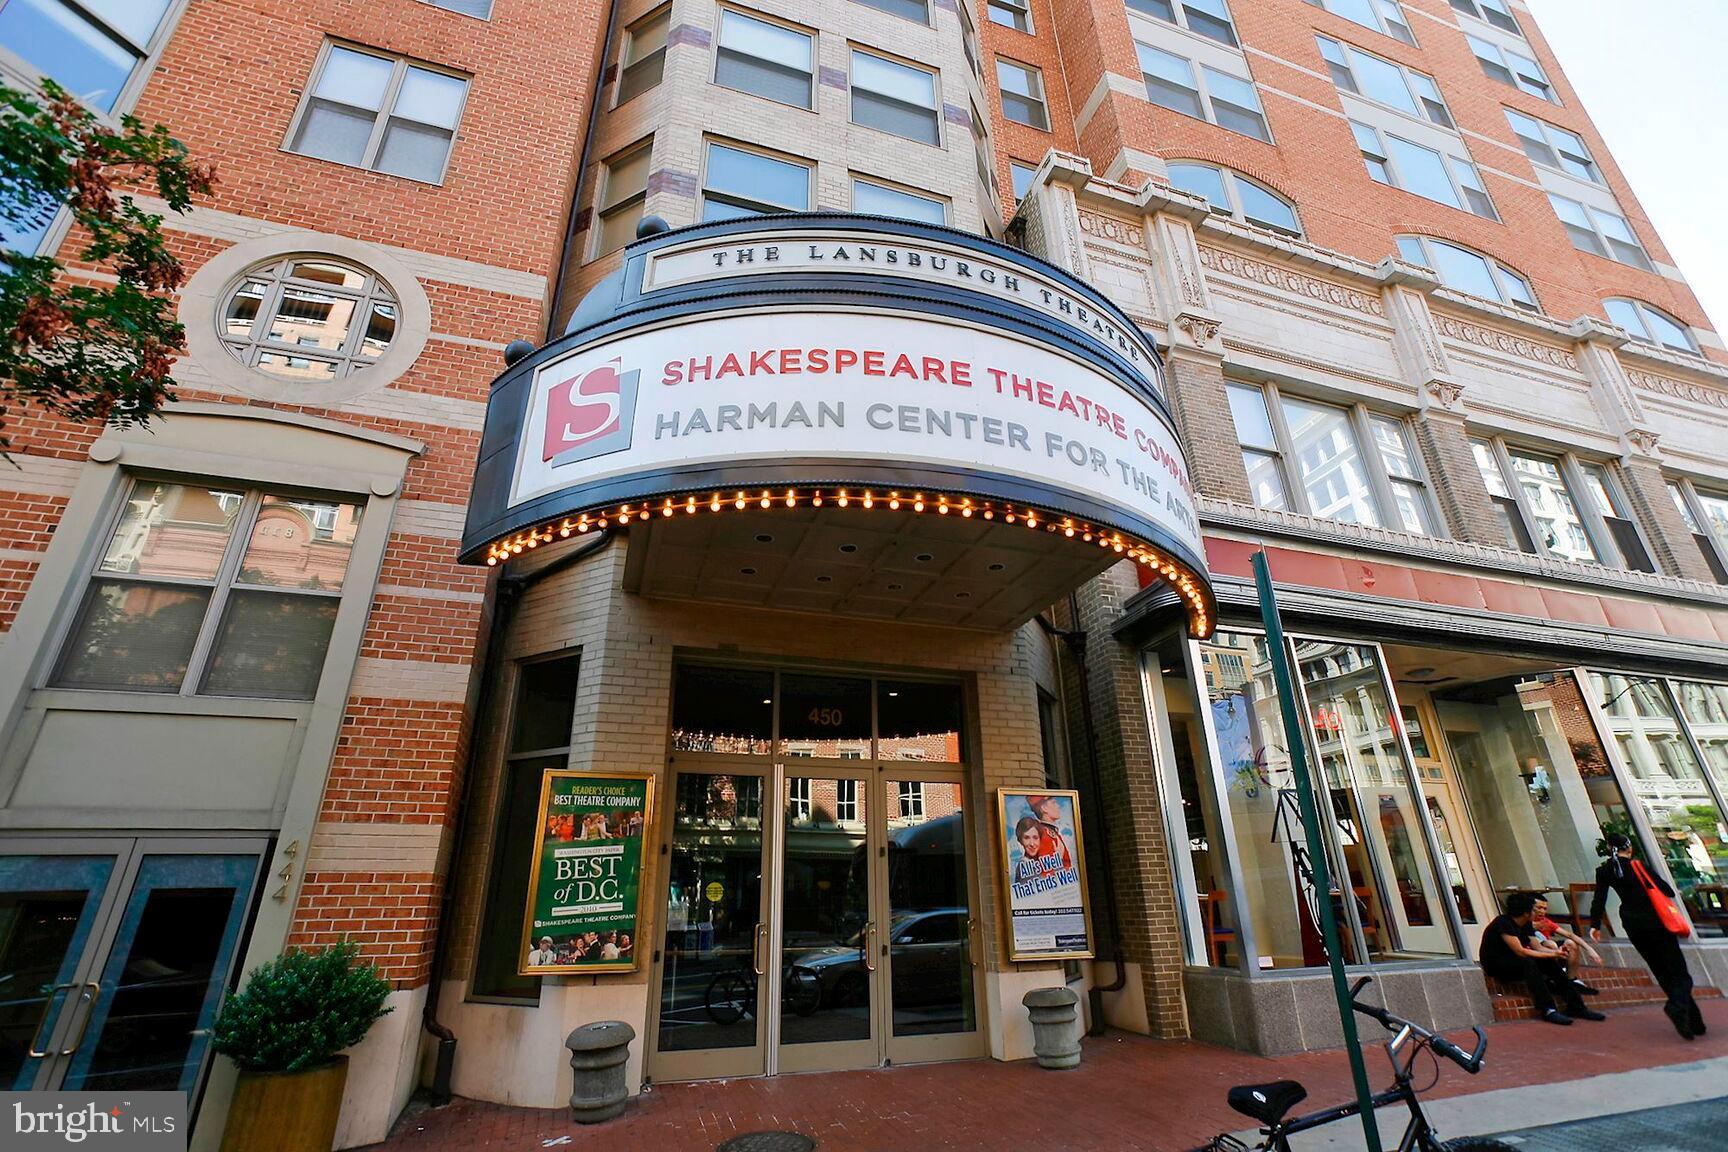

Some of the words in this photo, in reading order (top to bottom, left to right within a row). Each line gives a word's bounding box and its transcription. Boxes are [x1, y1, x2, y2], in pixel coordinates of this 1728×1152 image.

[713, 246, 779, 267] THE
[809, 245, 1020, 292] LANSBURGH
[1040, 288, 1139, 362] THEATRE
[562, 361, 621, 441] S
[661, 348, 972, 388] SHAKESPEARE
[987, 367, 1128, 440] THEATRE
[654, 401, 845, 441] HARMAN
[866, 402, 1032, 451] CENTER
[1045, 431, 1110, 477] FOR
[1116, 458, 1161, 504] THE
[1166, 491, 1197, 539] ARTS
[808, 707, 842, 726] 450
[554, 795, 572, 805] BEST
[573, 795, 605, 806] THEATRE
[606, 796, 641, 806] COMPANY
[572, 785, 603, 796] READER'S
[603, 787, 626, 796] CHOICE
[554, 857, 622, 881] BEST
[1020, 859, 1042, 878] All's
[1041, 852, 1062, 871] Well
[554, 882, 574, 904] of
[576, 879, 624, 902] D.C.
[1012, 880, 1035, 899] That
[1035, 873, 1057, 893] Ends
[1057, 867, 1079, 886] Well
[542, 918, 583, 927] SHAKESPEARE
[584, 915, 609, 923] THEATRE
